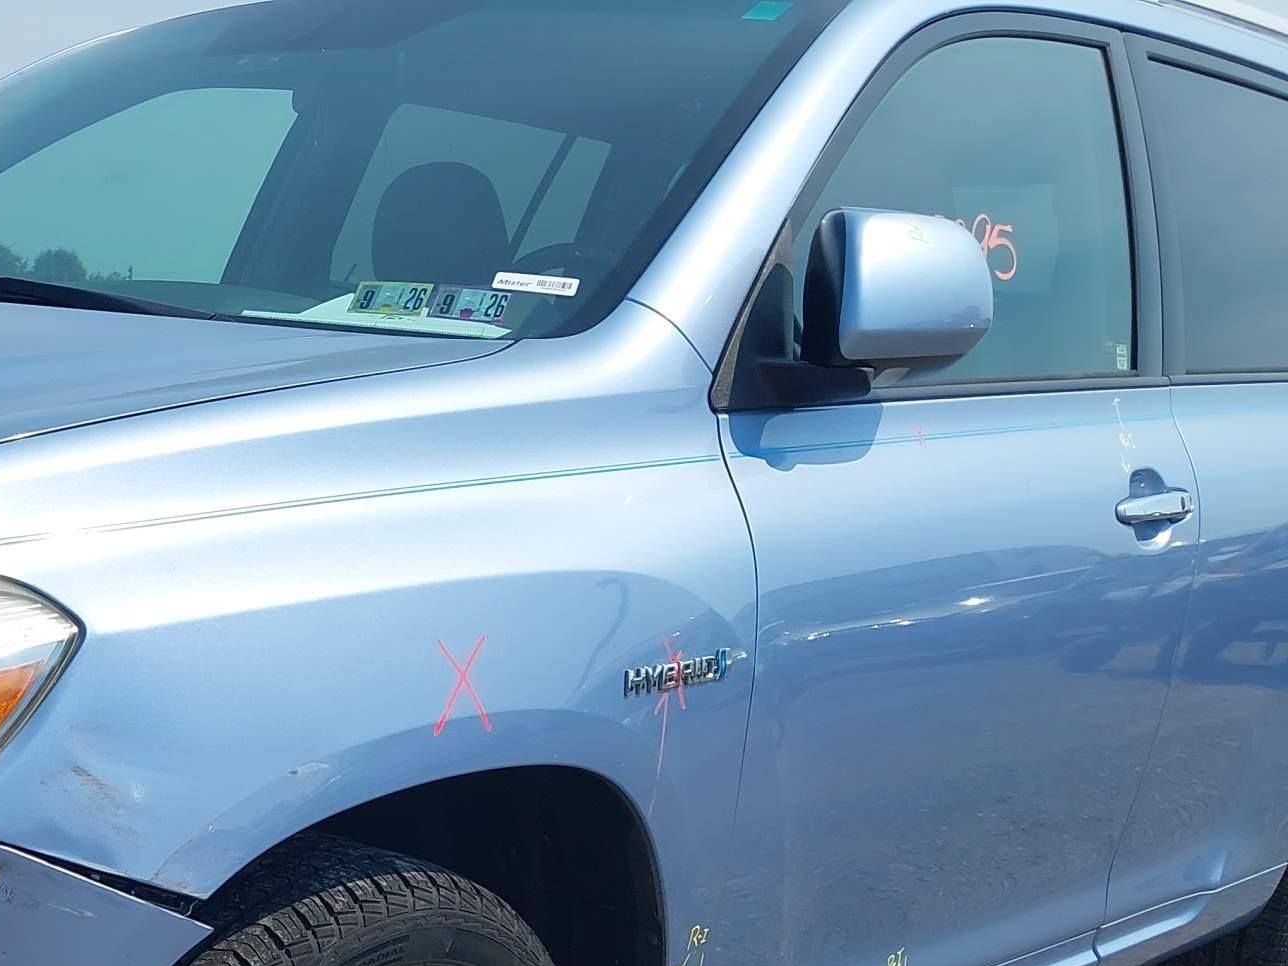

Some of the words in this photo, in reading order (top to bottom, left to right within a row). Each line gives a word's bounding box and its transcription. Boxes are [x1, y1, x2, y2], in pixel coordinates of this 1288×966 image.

[497, 279, 533, 287] Mister
[359, 289, 376, 309] 9
[403, 287, 428, 311] 26
[439, 294, 456, 315] 9
[484, 293, 509, 318] 26
[624, 655, 718, 698] HYBRID
